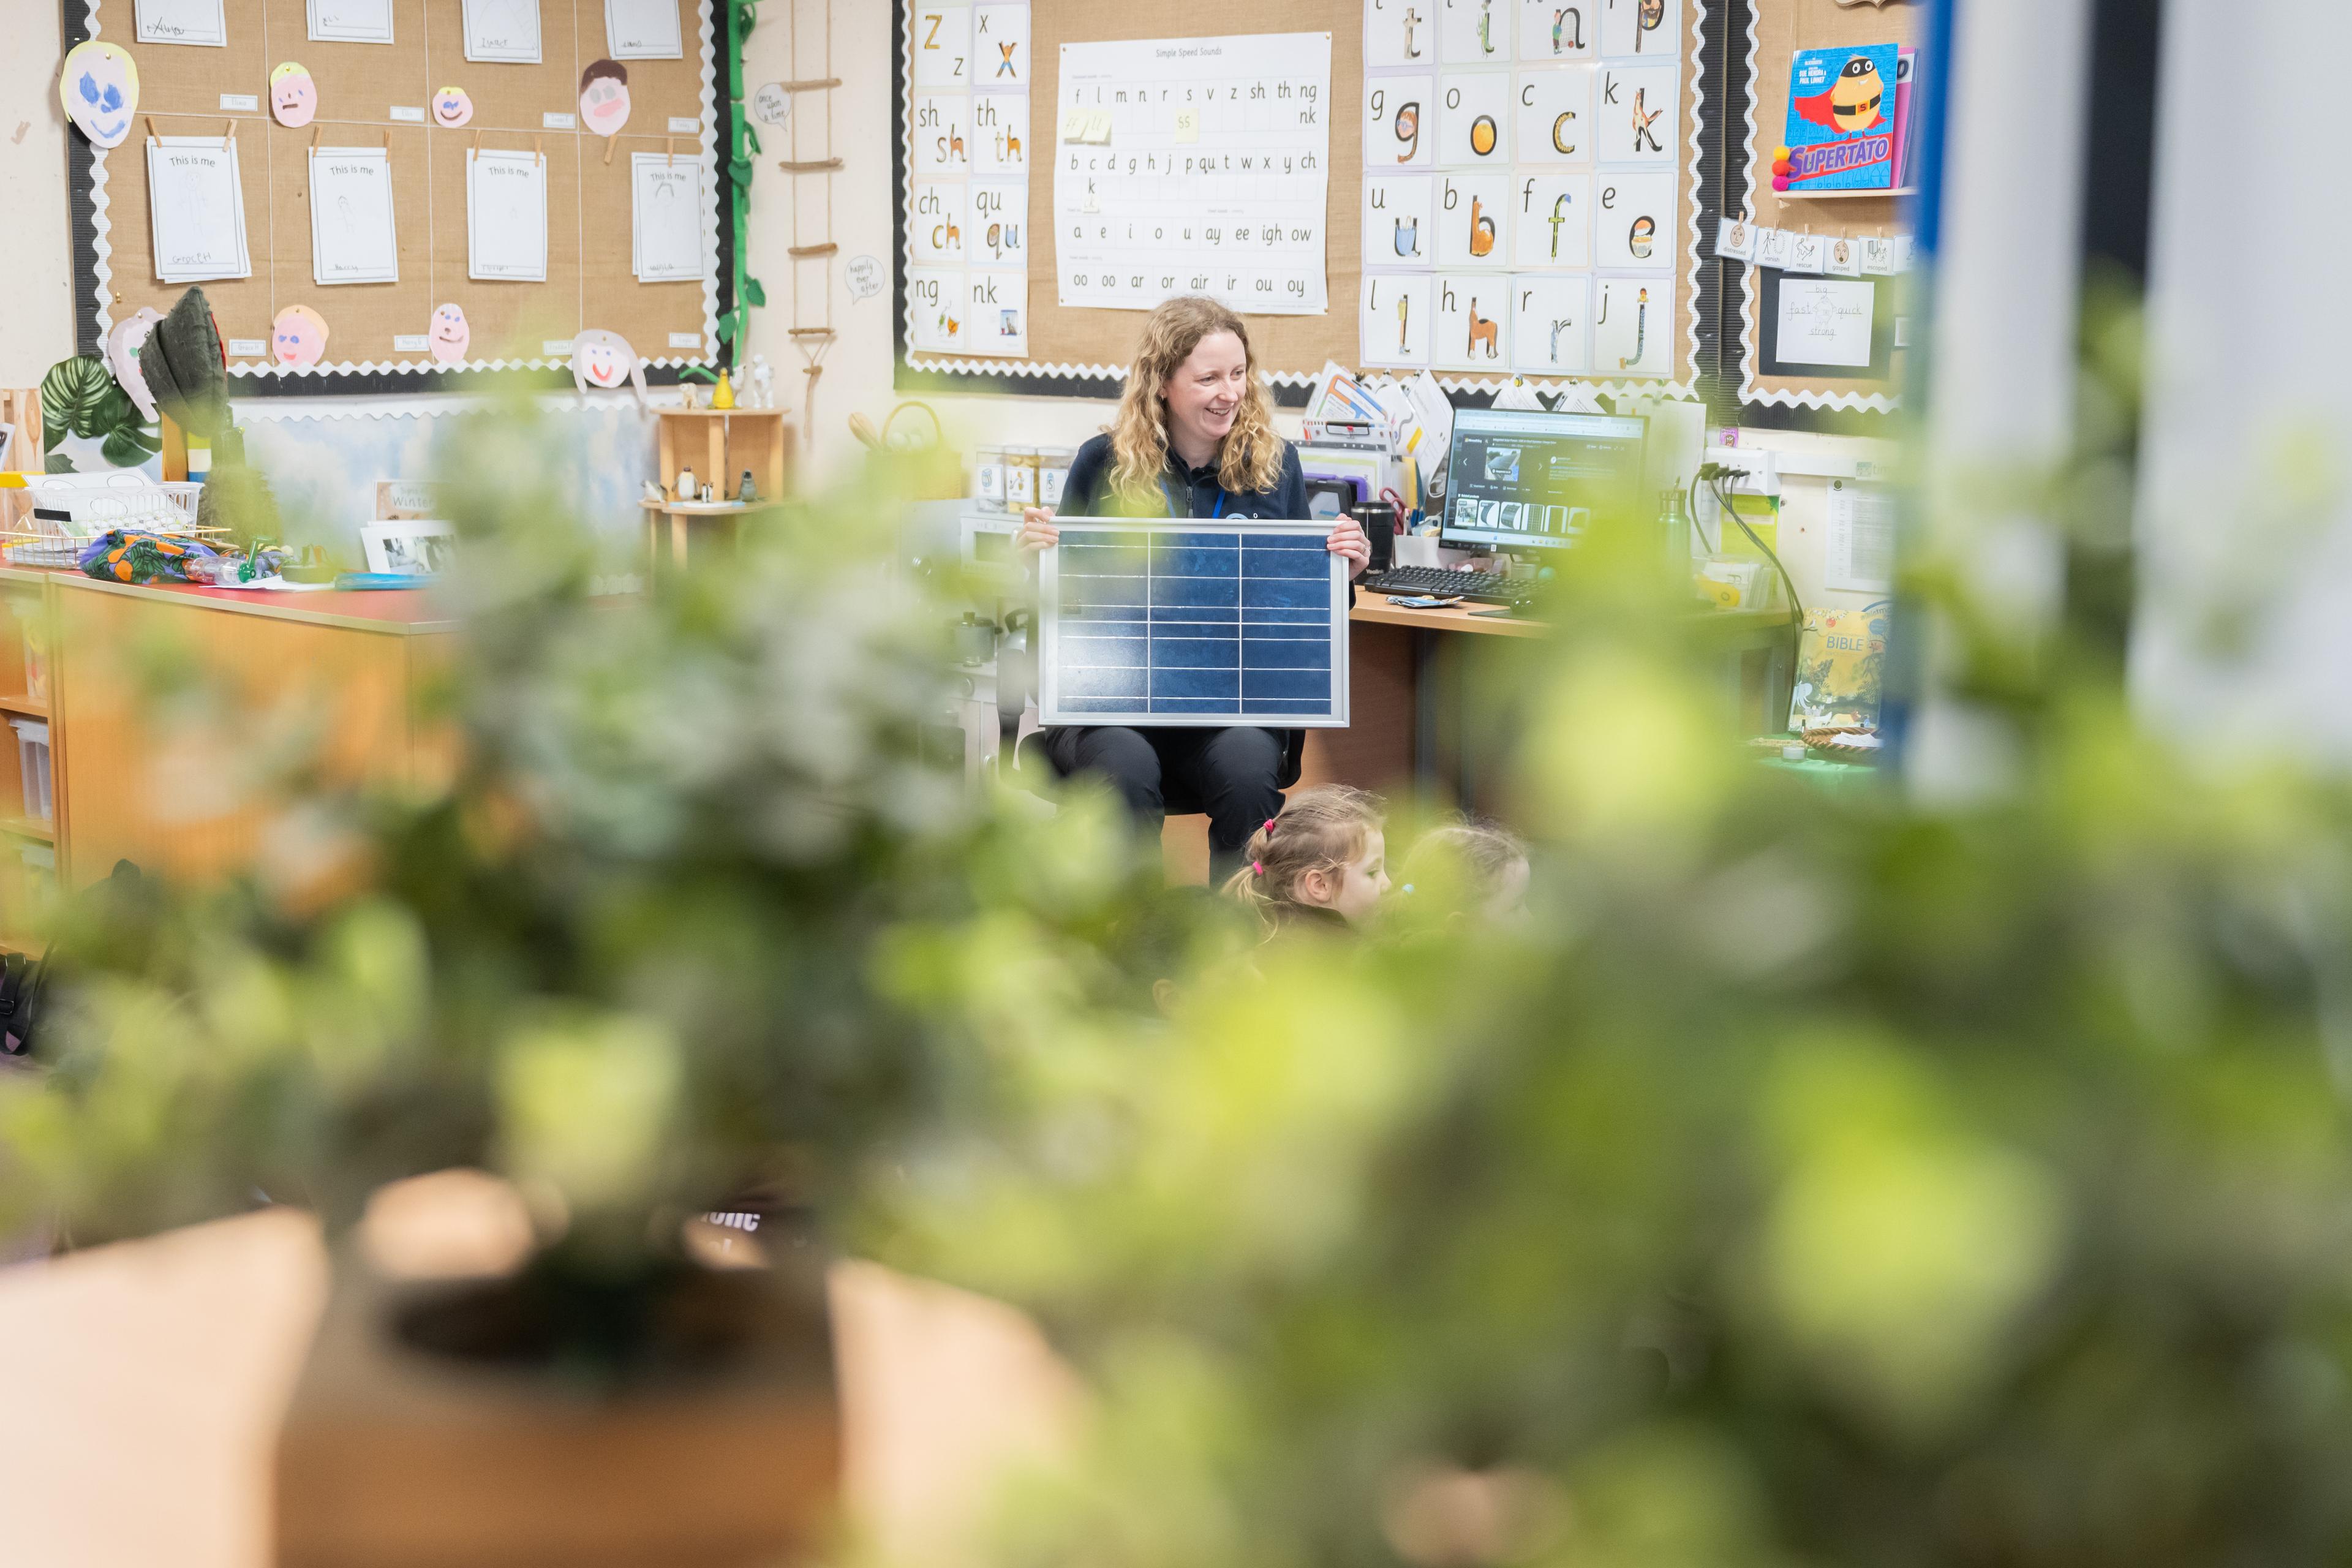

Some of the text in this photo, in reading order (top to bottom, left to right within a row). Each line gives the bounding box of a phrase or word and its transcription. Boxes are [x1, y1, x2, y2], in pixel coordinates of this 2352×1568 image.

[1552, 7, 1585, 55] n
[1156, 47, 1223, 59] Simple Speed Sounds
[1250, 81, 1265, 99] sh
[1278, 80, 1291, 99] th
[1300, 85, 1317, 103] ng
[1604, 71, 1619, 105] k
[919, 99, 940, 127] sh
[977, 98, 997, 127] th
[1300, 105, 1317, 124] nk
[1371, 90, 1384, 121] g
[169, 157, 190, 167] This
[329, 165, 374, 176] This is me
[1071, 151, 1316, 175] b c d g h j p qu t w x y ch
[1787, 139, 1890, 179] SUPERTATO
[488, 167, 505, 176] This
[508, 166, 514, 175] is
[650, 172, 665, 181] This
[1088, 177, 1095, 194] k
[1444, 178, 1457, 210] b
[1523, 178, 1535, 213] f
[919, 186, 940, 214] ch
[976, 191, 1001, 219] qu
[1371, 189, 1385, 208] u
[1602, 187, 1616, 209] e
[1074, 223, 1311, 246] a e i o u ay ee igh ow
[1723, 246, 1746, 255] distressed
[850, 259, 873, 275] happily
[861, 282, 878, 295] after
[916, 279, 938, 307] ng
[974, 276, 997, 304] nk
[1074, 274, 1304, 298] oo oo ar or air ir ou oy
[1442, 281, 1457, 312] h
[1815, 285, 1828, 295] big
[1522, 291, 1532, 312] r
[1597, 285, 1609, 325] j
[1788, 302, 1862, 320] fast quick
[1810, 327, 1836, 341] strong
[1826, 636, 1864, 651] BIBLE
